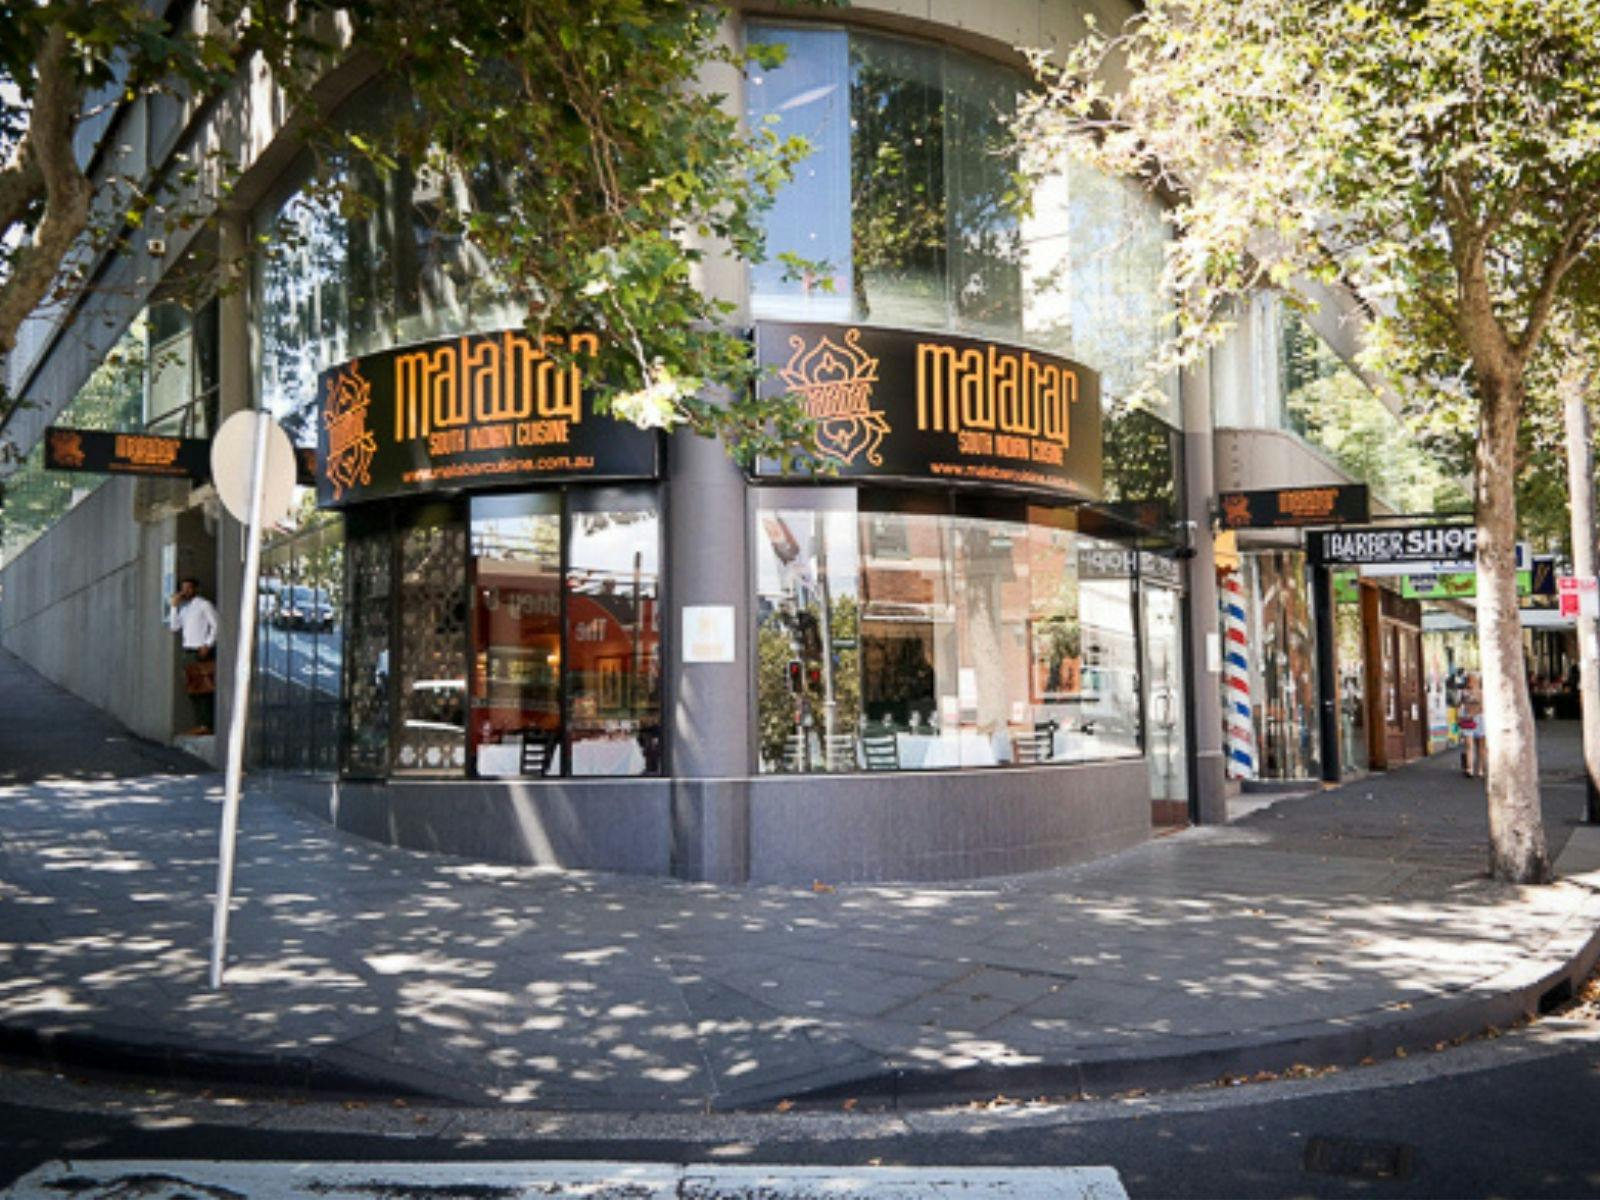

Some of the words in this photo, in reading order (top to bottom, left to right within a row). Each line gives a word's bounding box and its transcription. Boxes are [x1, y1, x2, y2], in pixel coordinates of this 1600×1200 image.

[917, 343, 1079, 449] malabar
[516, 420, 570, 446] CUISINE
[1407, 527, 1478, 554] SHOP
